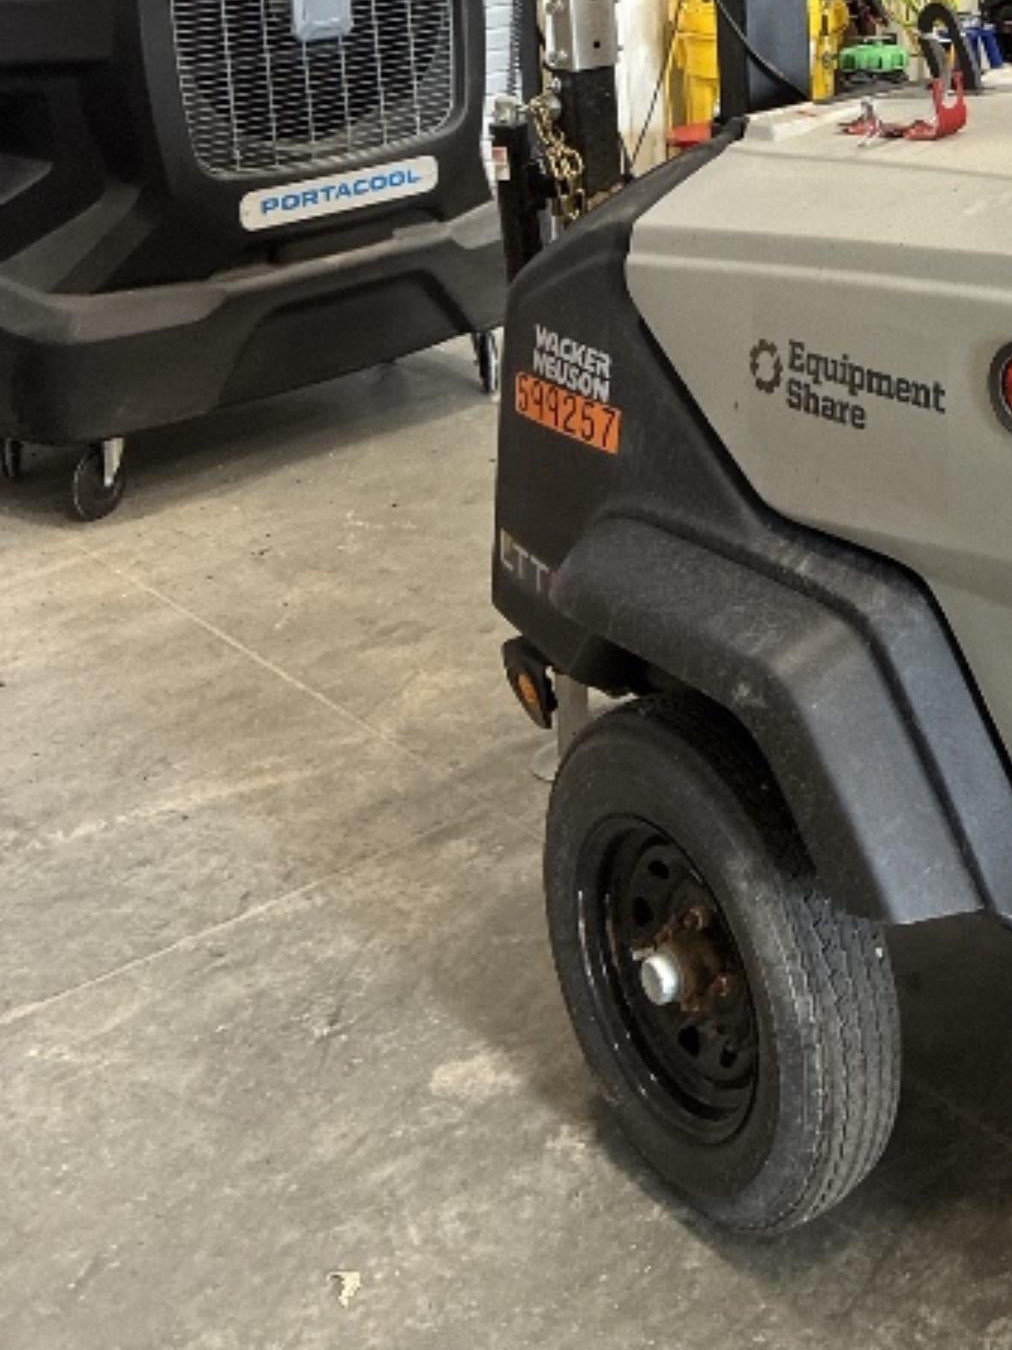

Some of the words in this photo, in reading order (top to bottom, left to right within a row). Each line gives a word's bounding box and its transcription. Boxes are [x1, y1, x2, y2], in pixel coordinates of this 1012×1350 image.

[260, 169, 422, 216] PORTACOOL
[532, 348, 610, 404] NEUSON
[535, 323, 612, 379] WACKER
[787, 338, 946, 415] Equipment
[518, 373, 616, 449] 599257
[785, 377, 866, 430] Share
